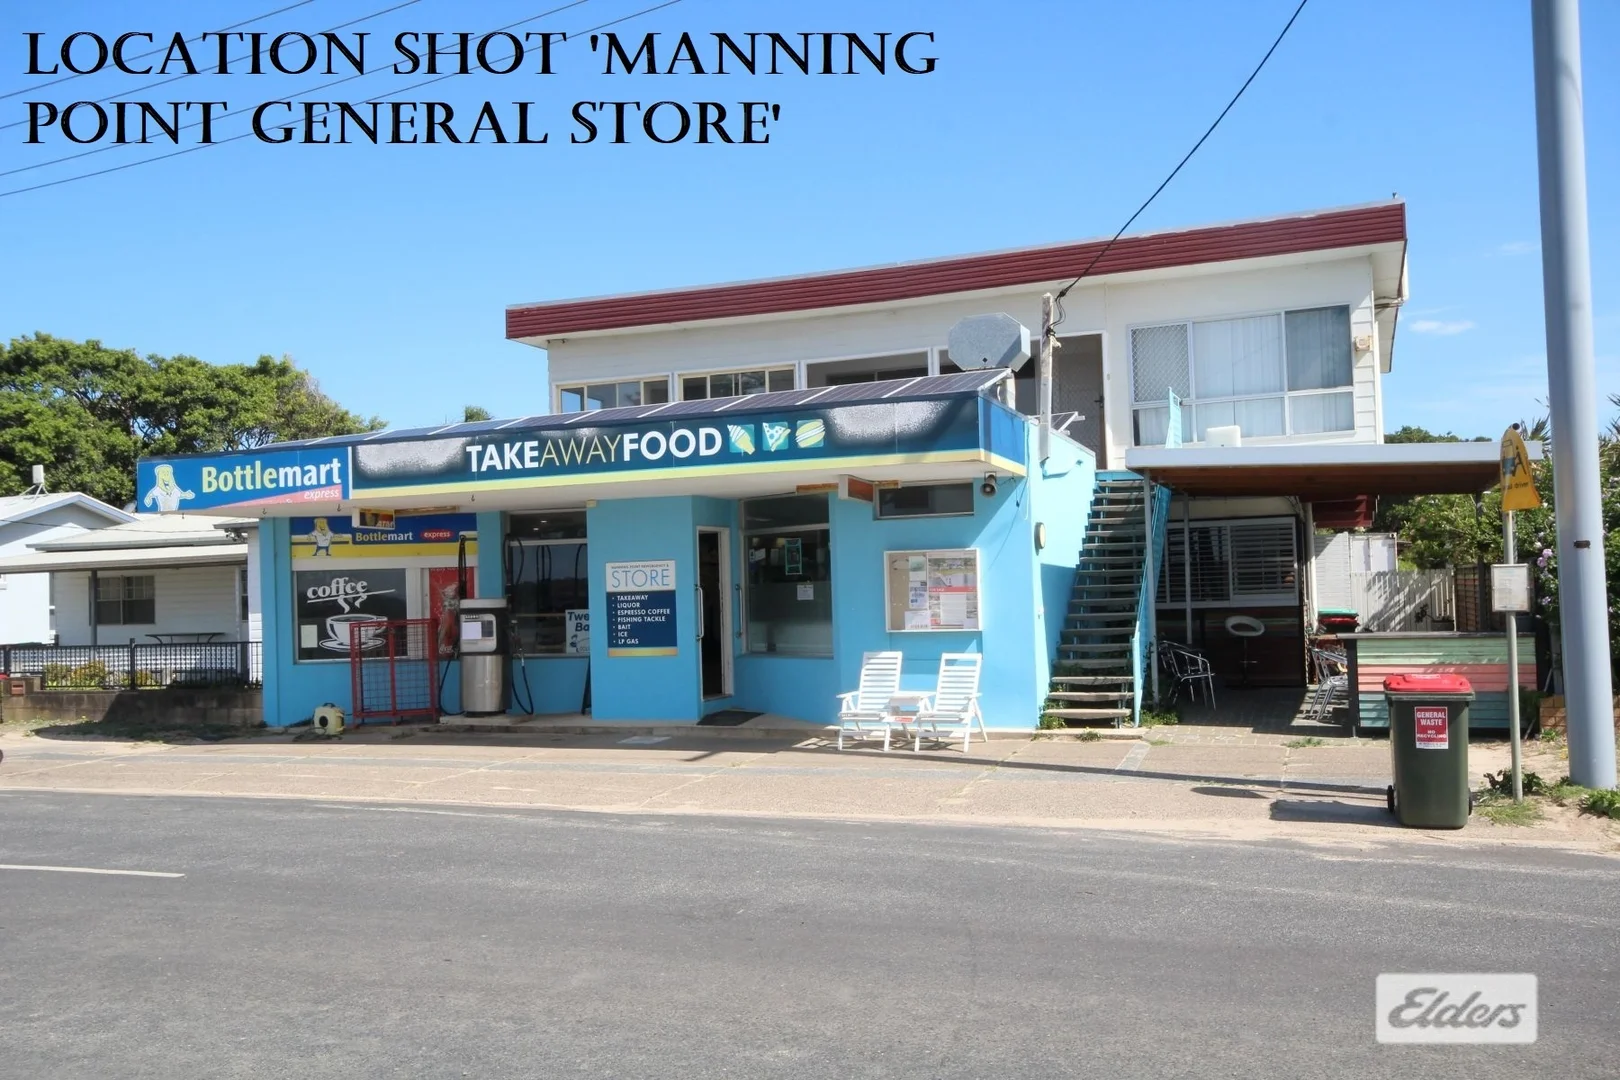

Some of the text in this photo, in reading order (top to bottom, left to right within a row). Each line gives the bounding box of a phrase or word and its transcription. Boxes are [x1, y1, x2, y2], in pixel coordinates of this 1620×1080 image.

[201, 457, 342, 493] Bottlemart
[303, 488, 340, 501] express
[355, 530, 450, 542] Bottlemart express
[306, 577, 368, 599] coffee
[611, 569, 670, 588] STORE
